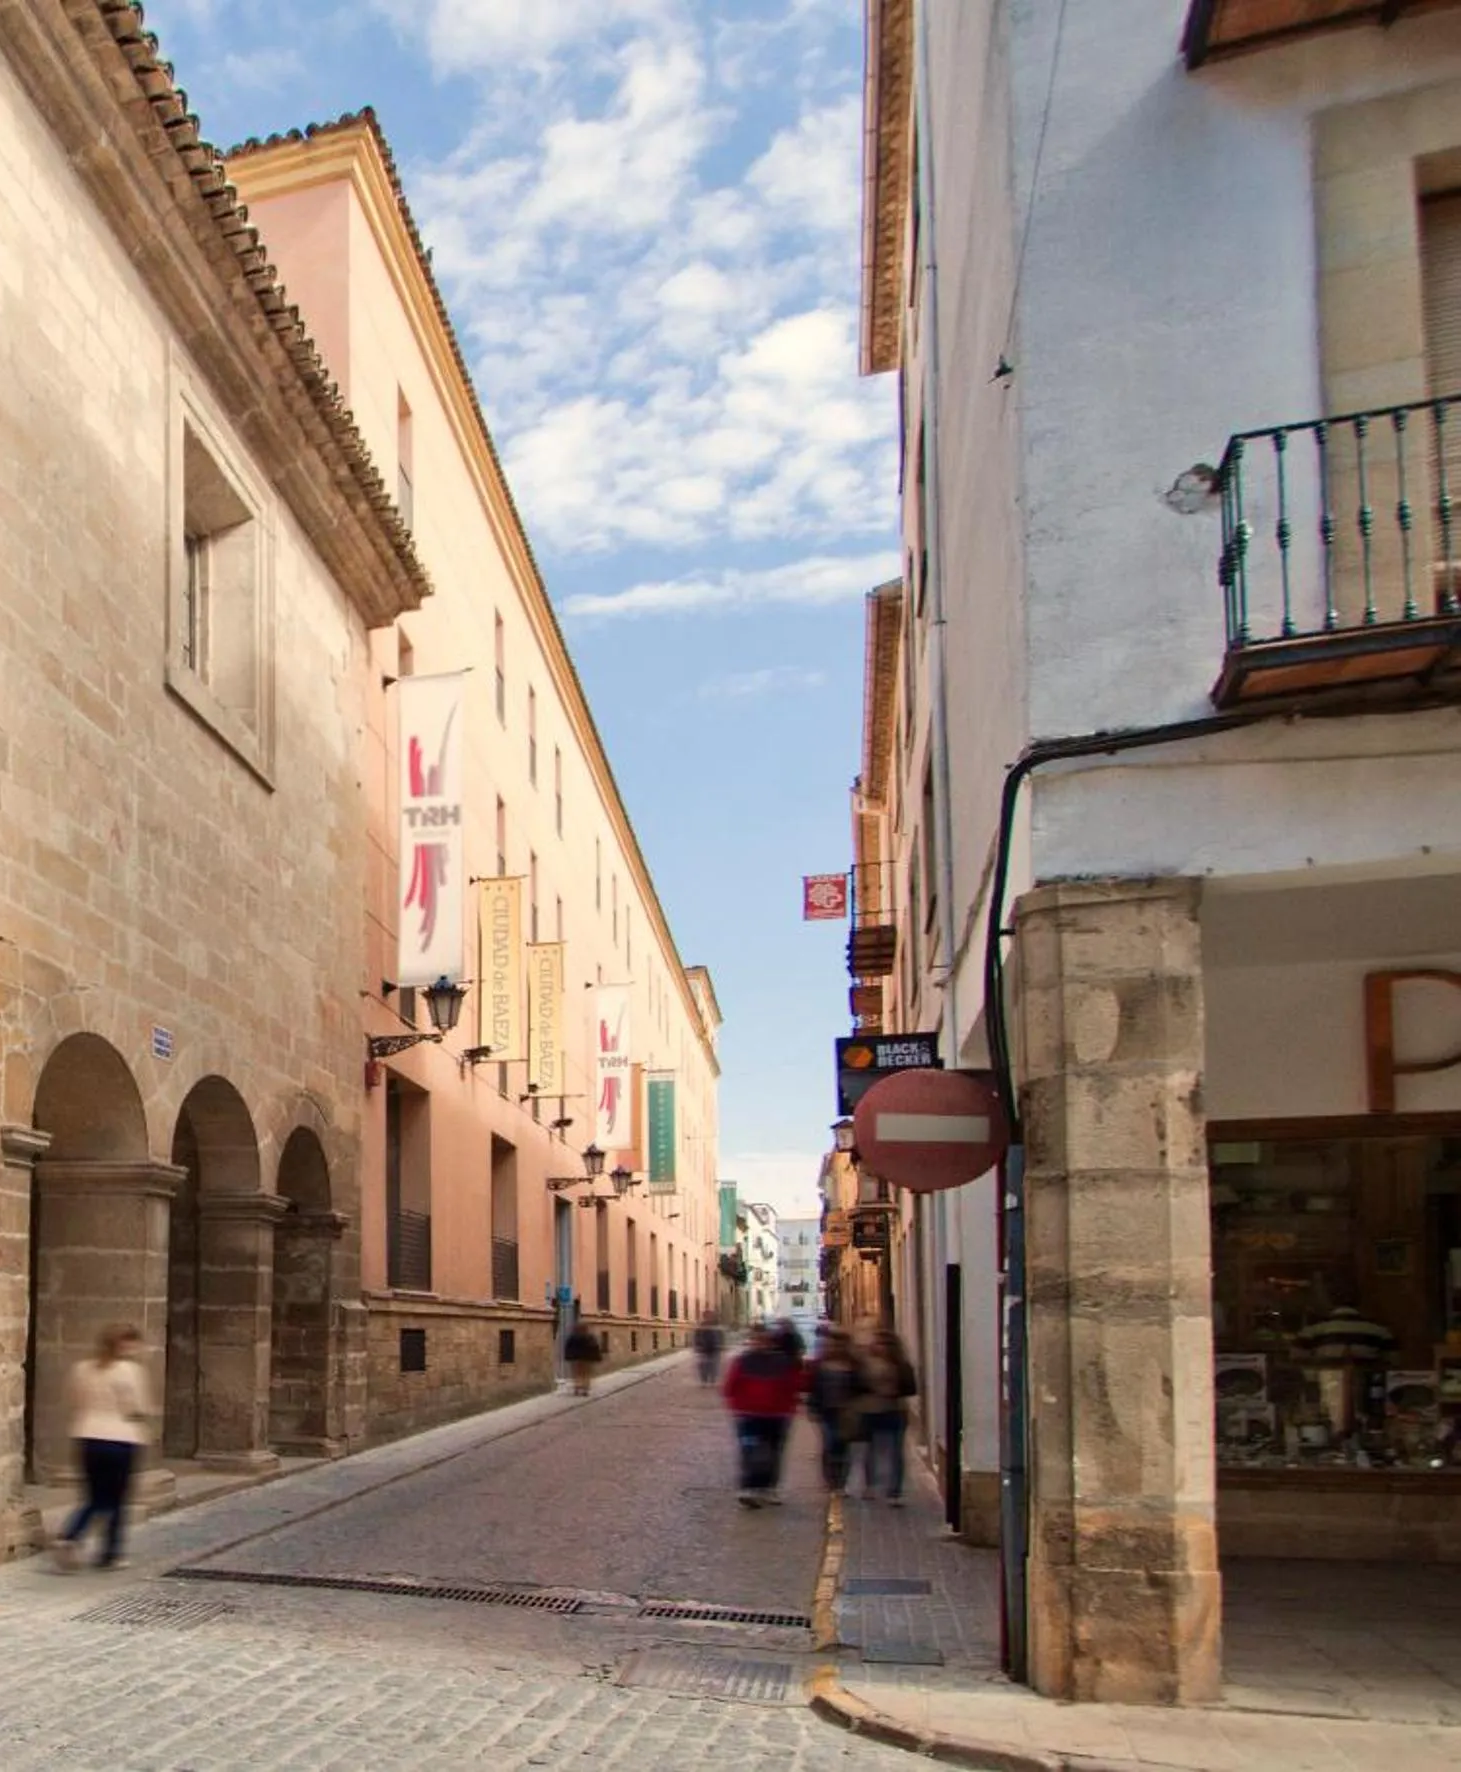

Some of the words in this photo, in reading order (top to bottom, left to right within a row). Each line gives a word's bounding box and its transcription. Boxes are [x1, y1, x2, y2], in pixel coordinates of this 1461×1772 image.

[492, 896, 510, 968] CIUDAD
[493, 970, 508, 992] de
[539, 957, 553, 1019] CIUDAD
[493, 994, 510, 1052] BAEZA
[540, 1040, 555, 1090] BAEZA
[877, 1053, 932, 1068] DECKER
